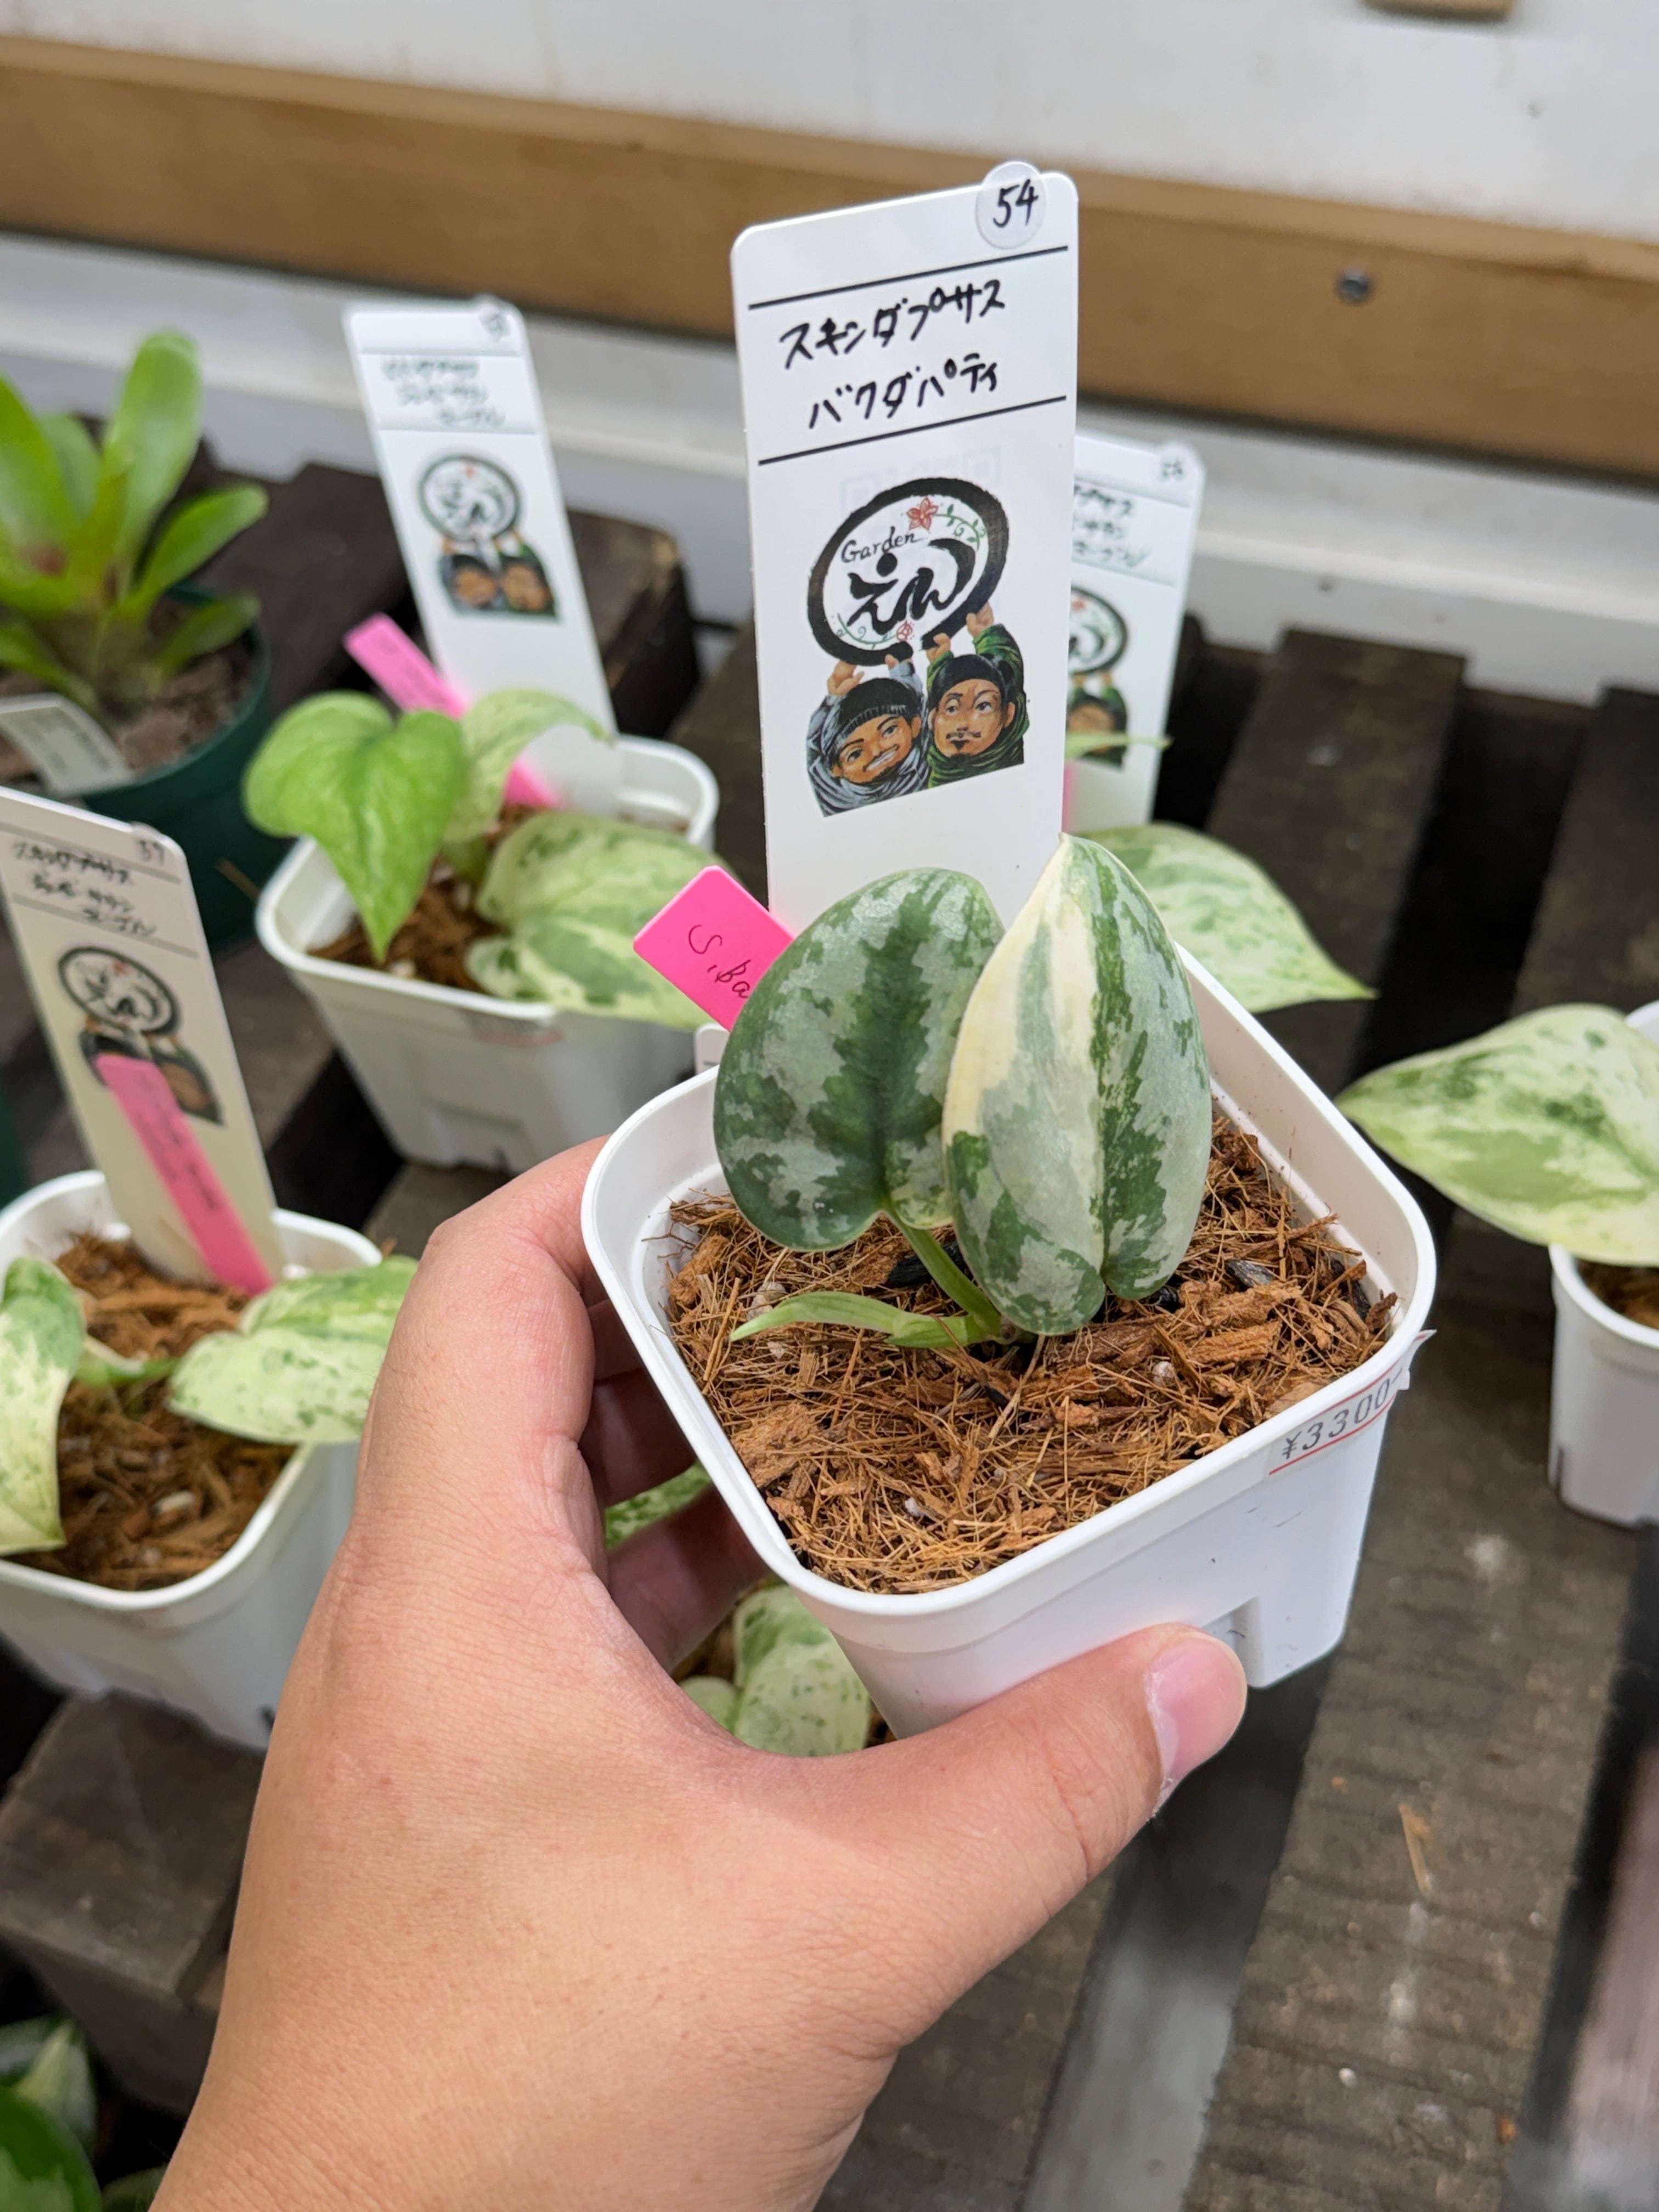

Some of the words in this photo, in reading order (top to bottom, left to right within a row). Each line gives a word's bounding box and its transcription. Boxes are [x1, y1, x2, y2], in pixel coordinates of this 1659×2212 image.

[992, 178, 1039, 228] 54
[779, 279, 1005, 370] スキンダプサス
[840, 526, 927, 563] Garden
